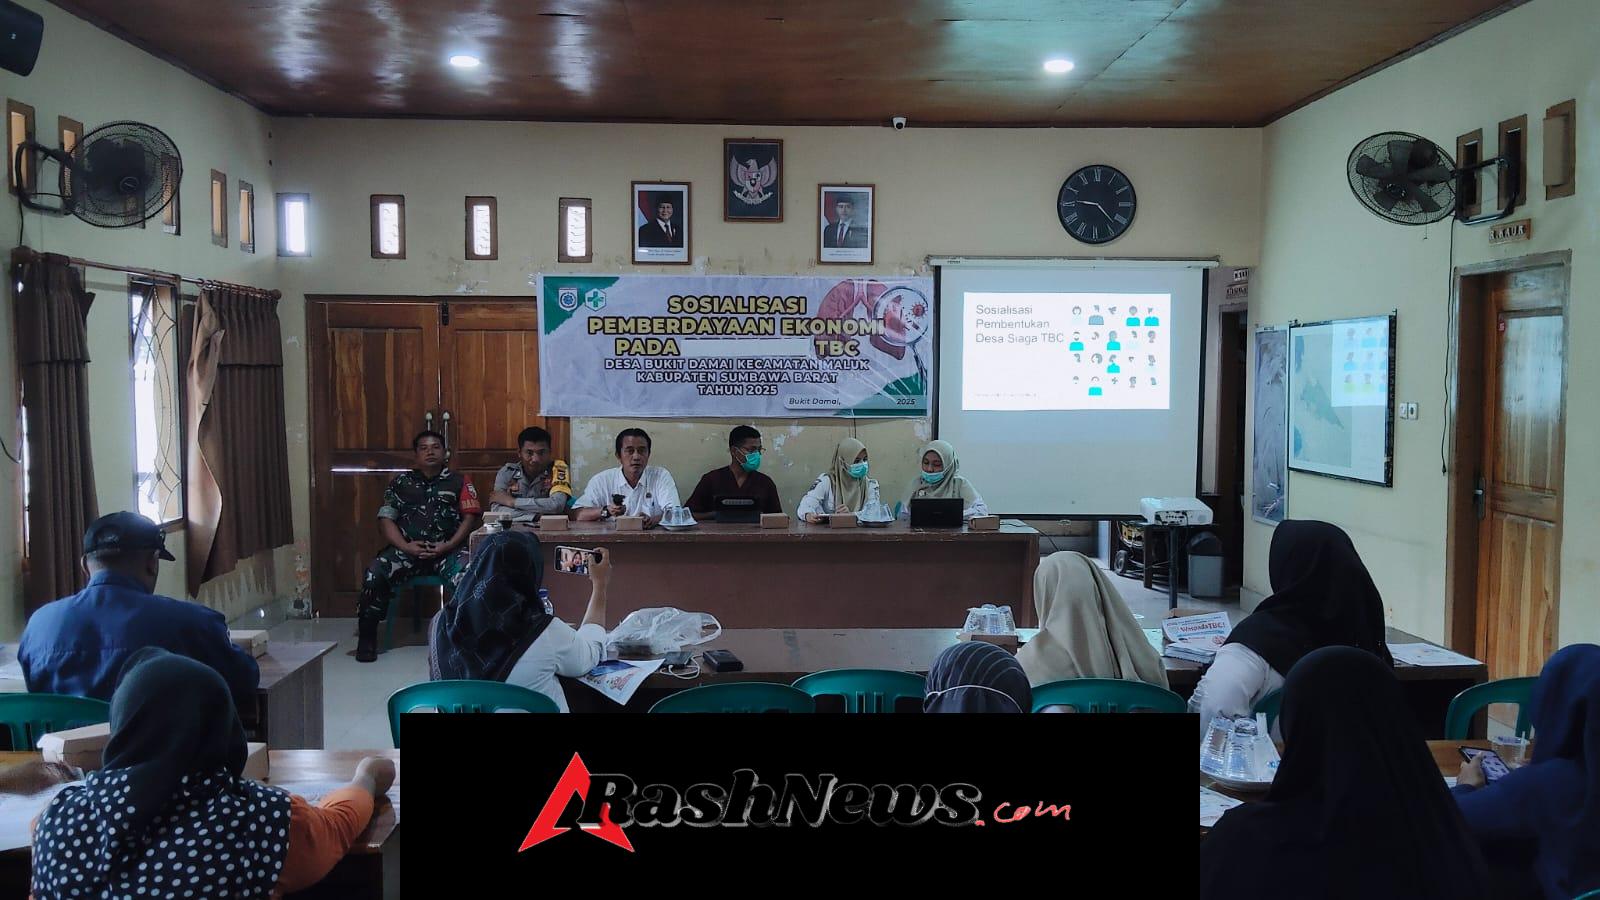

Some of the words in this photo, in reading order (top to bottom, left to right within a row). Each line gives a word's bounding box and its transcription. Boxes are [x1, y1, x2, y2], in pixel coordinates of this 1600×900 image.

[667, 295, 807, 315] SOSIALISASI
[976, 304, 1033, 315] Sosialisasi
[588, 317, 775, 336] PEMBERDAYAAN
[781, 317, 885, 337] EKONOMI
[975, 319, 1050, 329] Pembentukan
[975, 333, 1004, 343] Desa
[1007, 333, 1038, 346] Siaga
[1041, 333, 1064, 343] TBC
[615, 338, 680, 356] PADA
[815, 339, 861, 357] TBC
[605, 359, 641, 370] DESA
[644, 359, 686, 370] BUKIT
[689, 359, 734, 370] DAMAI
[737, 359, 818, 371] KECAMATAN
[822, 359, 870, 371] MALUK
[636, 371, 717, 383] KABUPATEN
[720, 372, 790, 383] SUMBAWA
[793, 372, 839, 383] BARAT
[697, 384, 743, 396] TAHUN
[746, 384, 778, 396] 2025
[788, 397, 810, 405] Bukit
[896, 398, 916, 406] 2025
